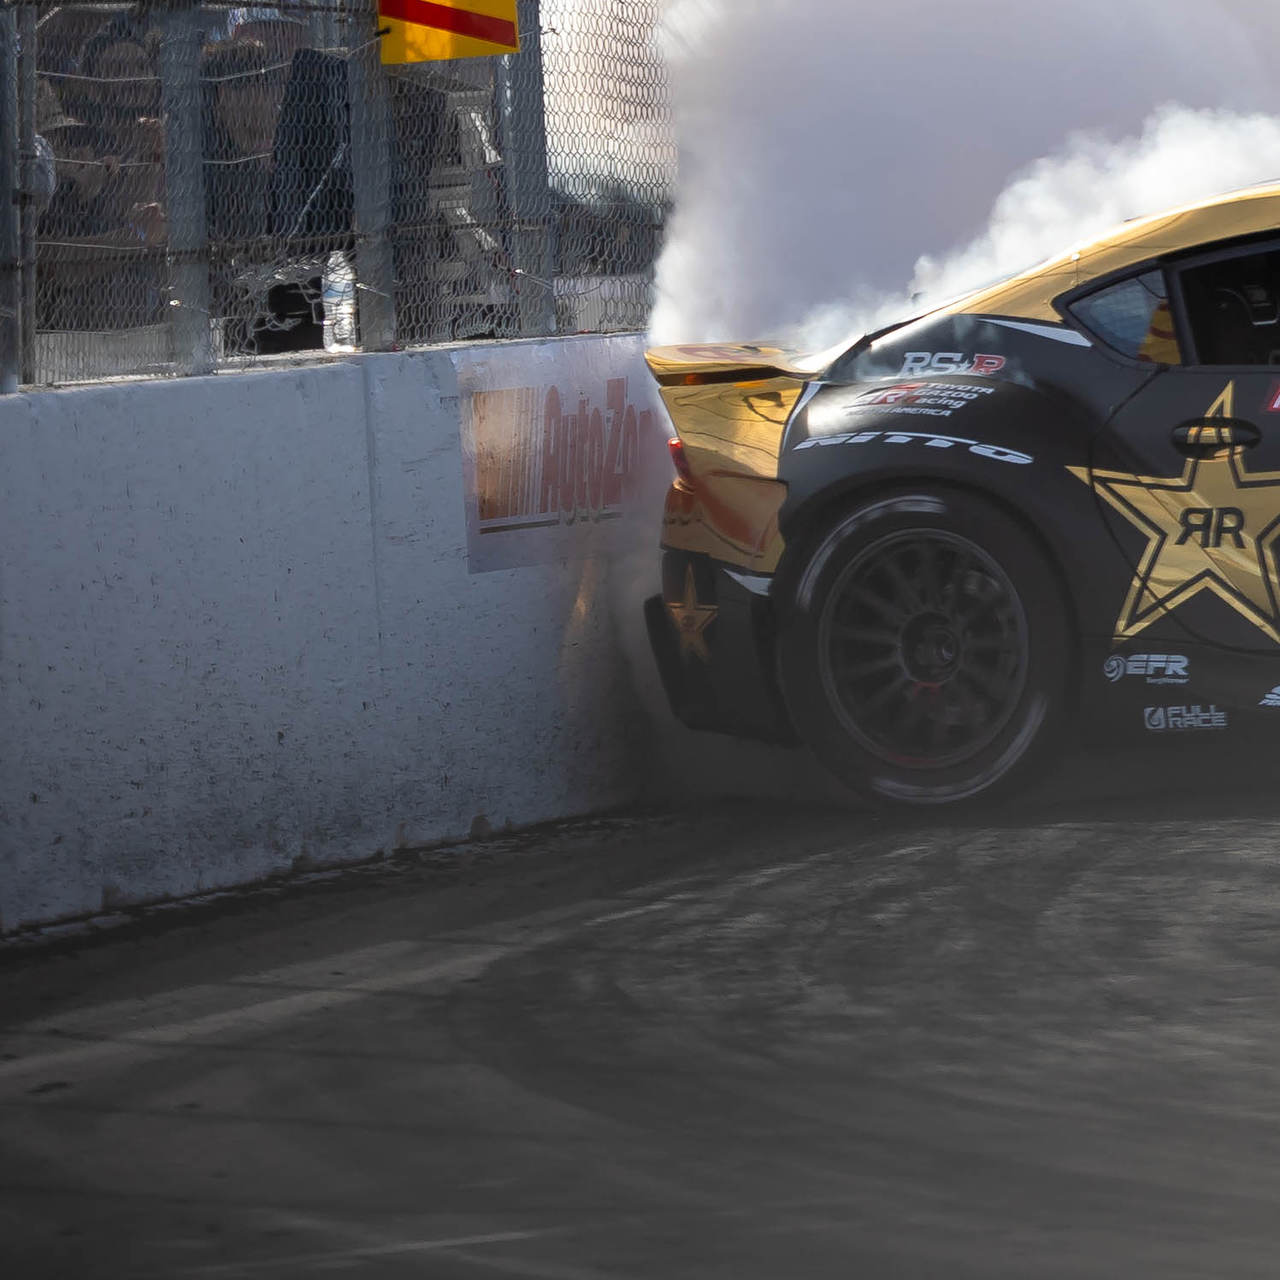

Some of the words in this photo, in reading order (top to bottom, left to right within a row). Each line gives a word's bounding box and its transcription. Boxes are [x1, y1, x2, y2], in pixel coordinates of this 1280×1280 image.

[915, 388, 979, 400] GAZOO
[926, 382, 995, 395] TOYOTA
[792, 431, 1034, 465] NITTO
[1125, 655, 1190, 675] EFR
